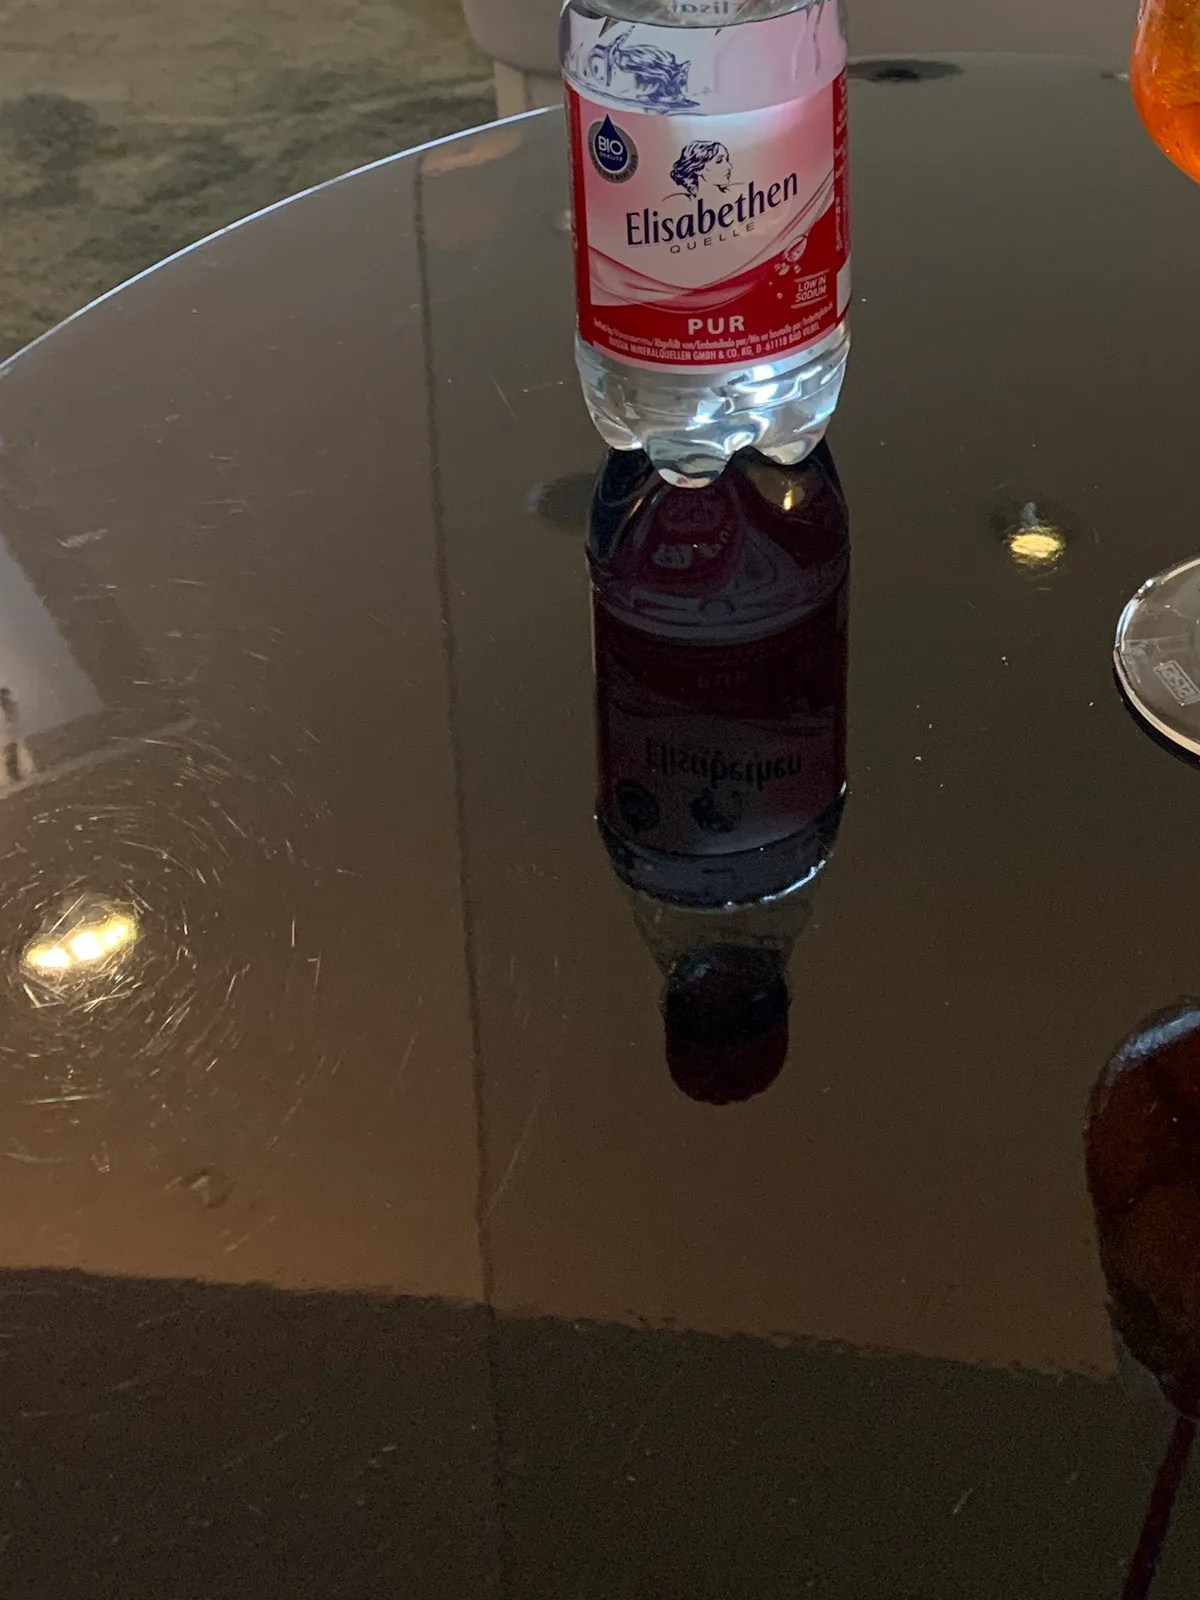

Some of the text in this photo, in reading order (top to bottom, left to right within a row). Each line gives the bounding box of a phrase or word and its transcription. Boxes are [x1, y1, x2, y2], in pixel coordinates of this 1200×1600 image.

[598, 135, 624, 156] BIO
[626, 172, 798, 246] Elisabethen
[669, 220, 756, 254] QUELLE
[794, 284, 828, 303] SODIUM
[797, 275, 828, 293] LOW IN
[687, 315, 746, 336] PUR
